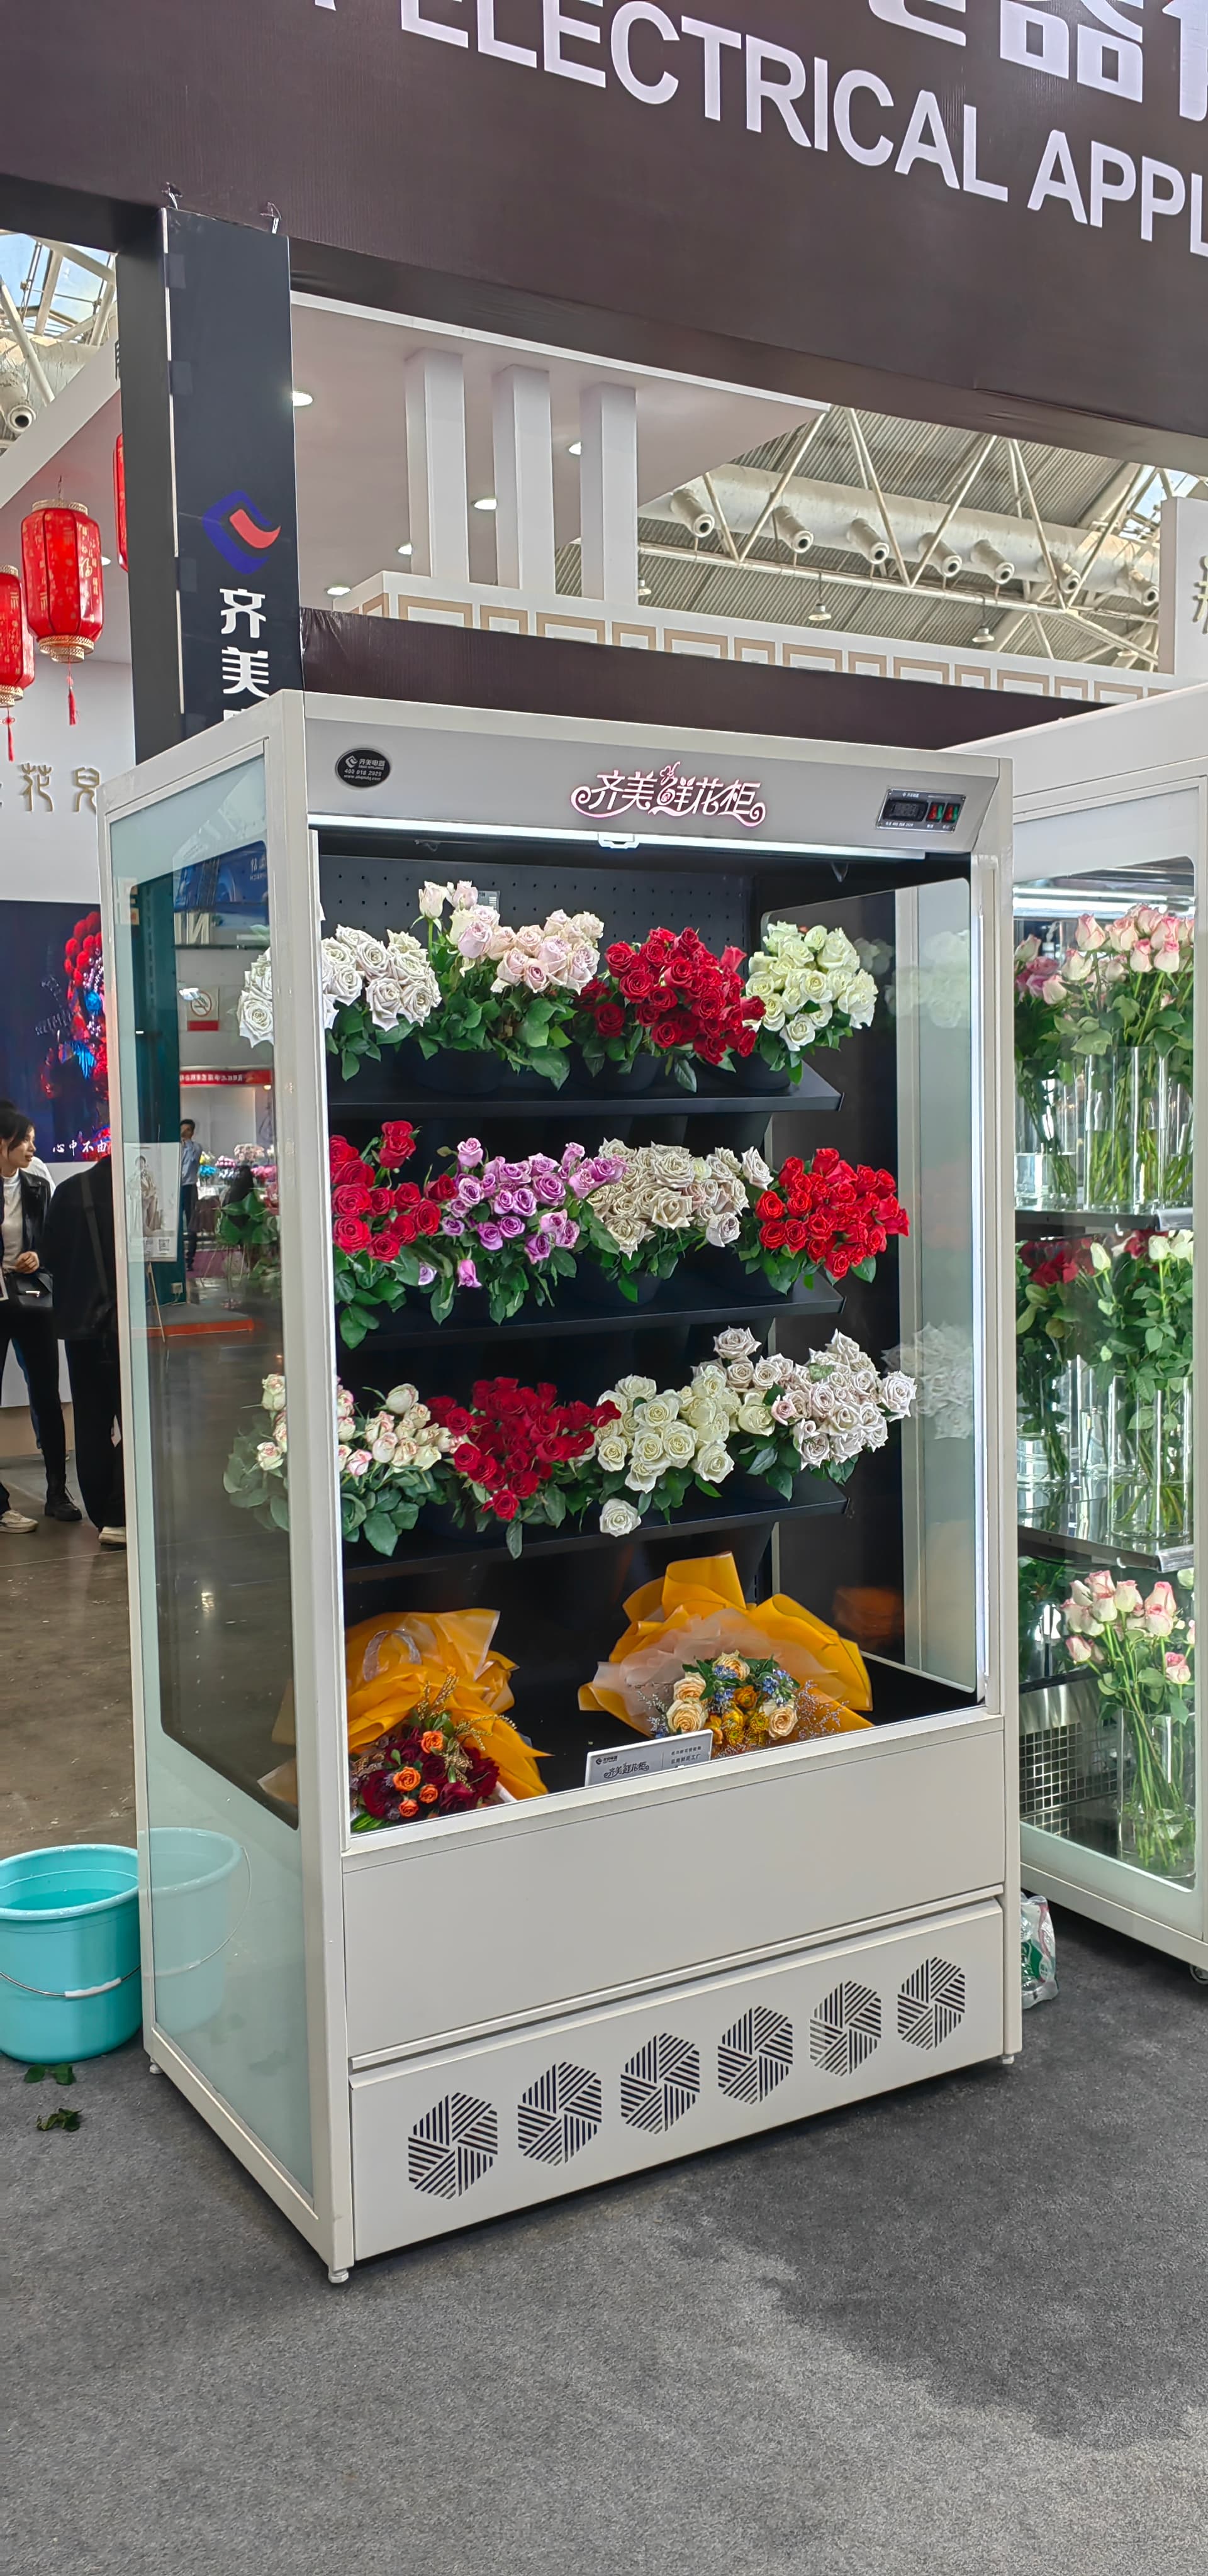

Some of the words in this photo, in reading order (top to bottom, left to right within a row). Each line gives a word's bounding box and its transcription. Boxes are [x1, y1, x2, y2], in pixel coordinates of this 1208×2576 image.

[220, 588, 271, 721] 齐美
[0, 763, 99, 813] 花兒
[570, 761, 766, 827] 齐美鲜花柜
